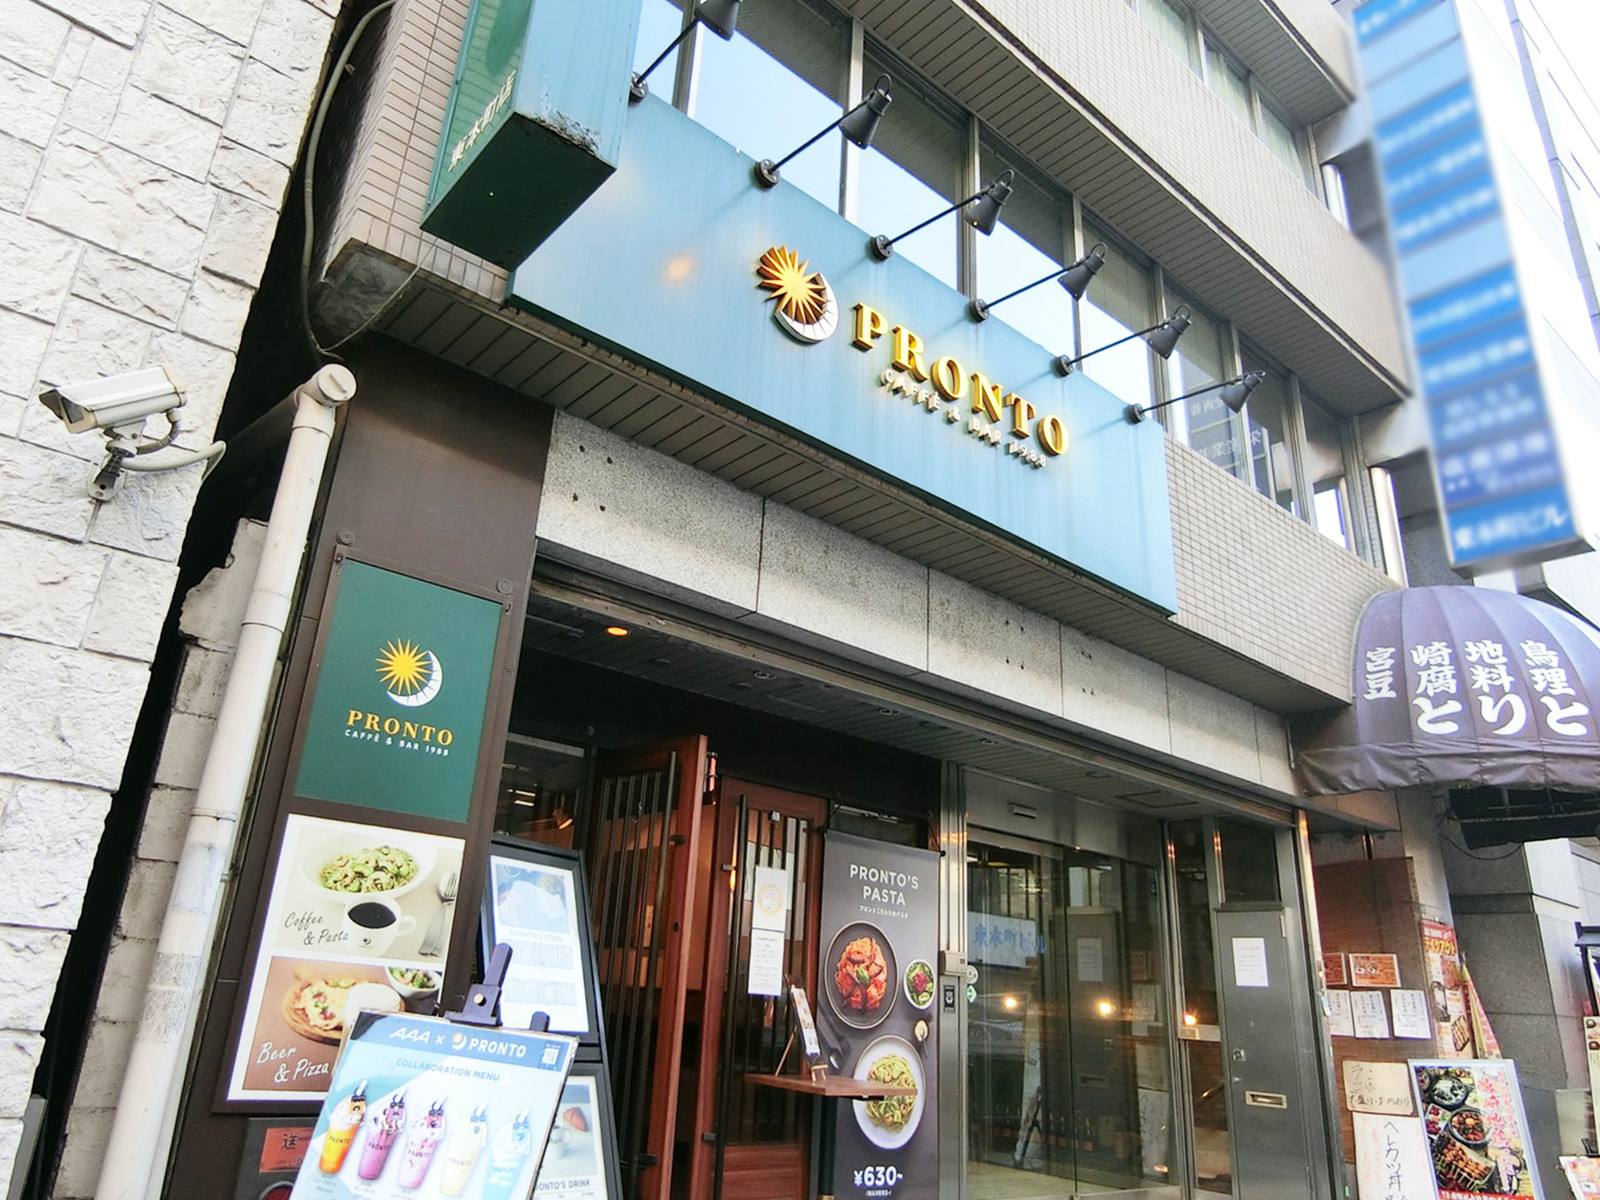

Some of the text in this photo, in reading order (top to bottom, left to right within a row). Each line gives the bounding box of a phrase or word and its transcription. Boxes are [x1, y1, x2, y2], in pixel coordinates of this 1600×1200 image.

[852, 301, 1070, 456] PRONTO
[946, 406, 961, 423] &
[967, 417, 1002, 447] BAR
[1008, 440, 1048, 469] 1988
[1362, 664, 1577, 700] 豆腐料理
[1412, 693, 1590, 737] とりと
[346, 709, 454, 747] PRONTO
[385, 736, 394, 746] &
[399, 740, 420, 751] BAR
[425, 745, 450, 757] 1988
[849, 864, 919, 890] PRONTO'S
[862, 885, 906, 907] PASTA
[284, 910, 324, 932] Coffee
[303, 928, 349, 946] & Pasta
[256, 1041, 297, 1064] Beer
[389, 1027, 430, 1044] AAA
[468, 1038, 527, 1058] PRONTO
[274, 1058, 329, 1083] & Pizza
[396, 1057, 500, 1082] COLLABORATION MENU
[568, 1179, 592, 1189] DRINK
